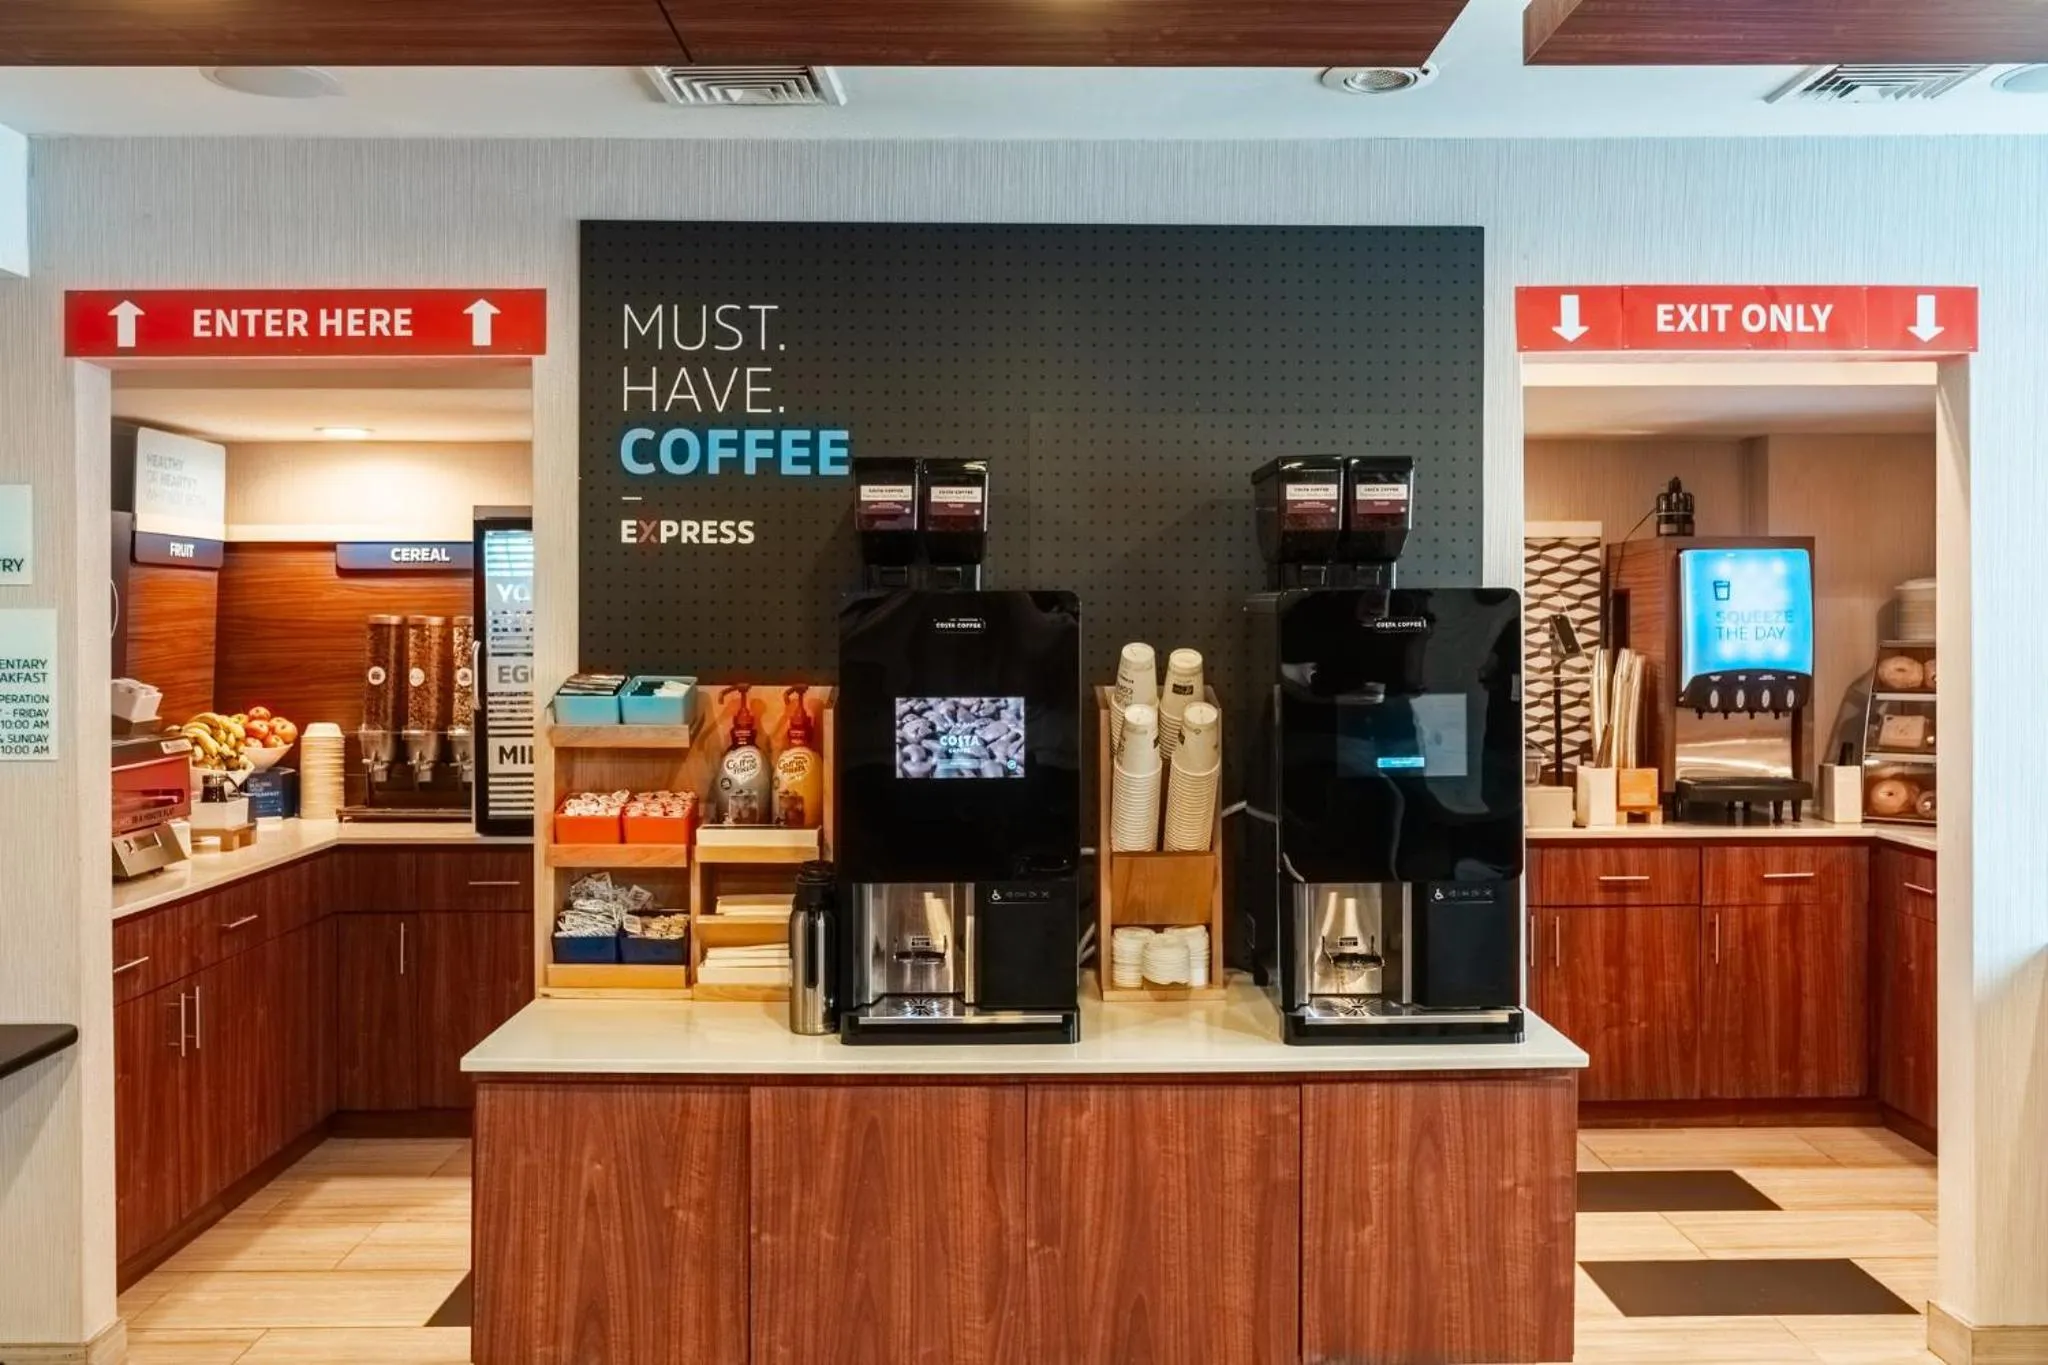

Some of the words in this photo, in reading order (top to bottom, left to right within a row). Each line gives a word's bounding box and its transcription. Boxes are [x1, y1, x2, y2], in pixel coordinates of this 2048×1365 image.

[193, 308, 309, 338] ENTER
[319, 308, 413, 337] HERE
[1656, 303, 1733, 333] EXIT
[1741, 303, 1834, 333] ONLY
[623, 303, 786, 351] MUST.
[623, 365, 785, 413] HAVE.
[620, 427, 850, 476] COFFEE
[620, 519, 755, 544] EXPRESS
[170, 542, 195, 558] FRUIT
[390, 547, 451, 562] CEREAL
[0, 557, 24, 572] RY
[1715, 609, 1795, 624] SQUEEZE
[1715, 626, 1748, 641] THE
[1755, 626, 1786, 641] DAY
[498, 665, 534, 684] EG
[13, 708, 49, 718] FRIDAY
[33, 719, 50, 729] AM
[8, 733, 49, 744] SUNDAY
[940, 735, 981, 747] COSTA
[33, 744, 50, 754] AM
